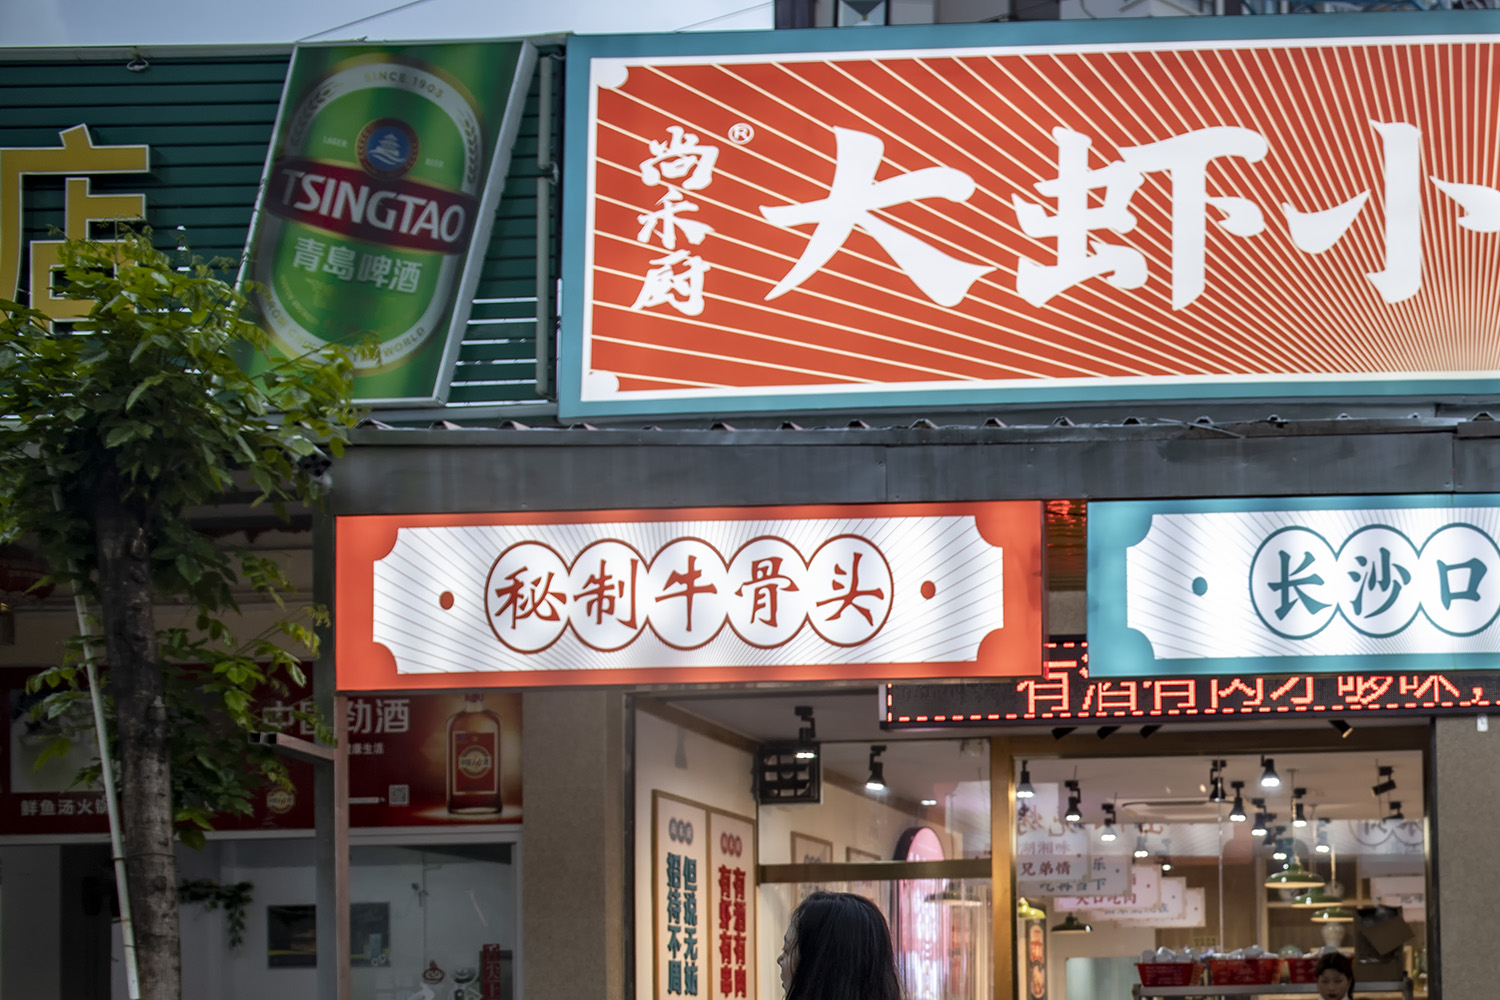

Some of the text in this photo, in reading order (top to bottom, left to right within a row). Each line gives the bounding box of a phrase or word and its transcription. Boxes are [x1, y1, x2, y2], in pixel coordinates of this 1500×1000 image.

[281, 168, 467, 243] TSINGTAO
[494, 551, 885, 632] 秘制牛骨头
[667, 852, 682, 996] 招待不周
[683, 855, 698, 997] 但说无妨
[733, 867, 746, 999] 有酒有肉
